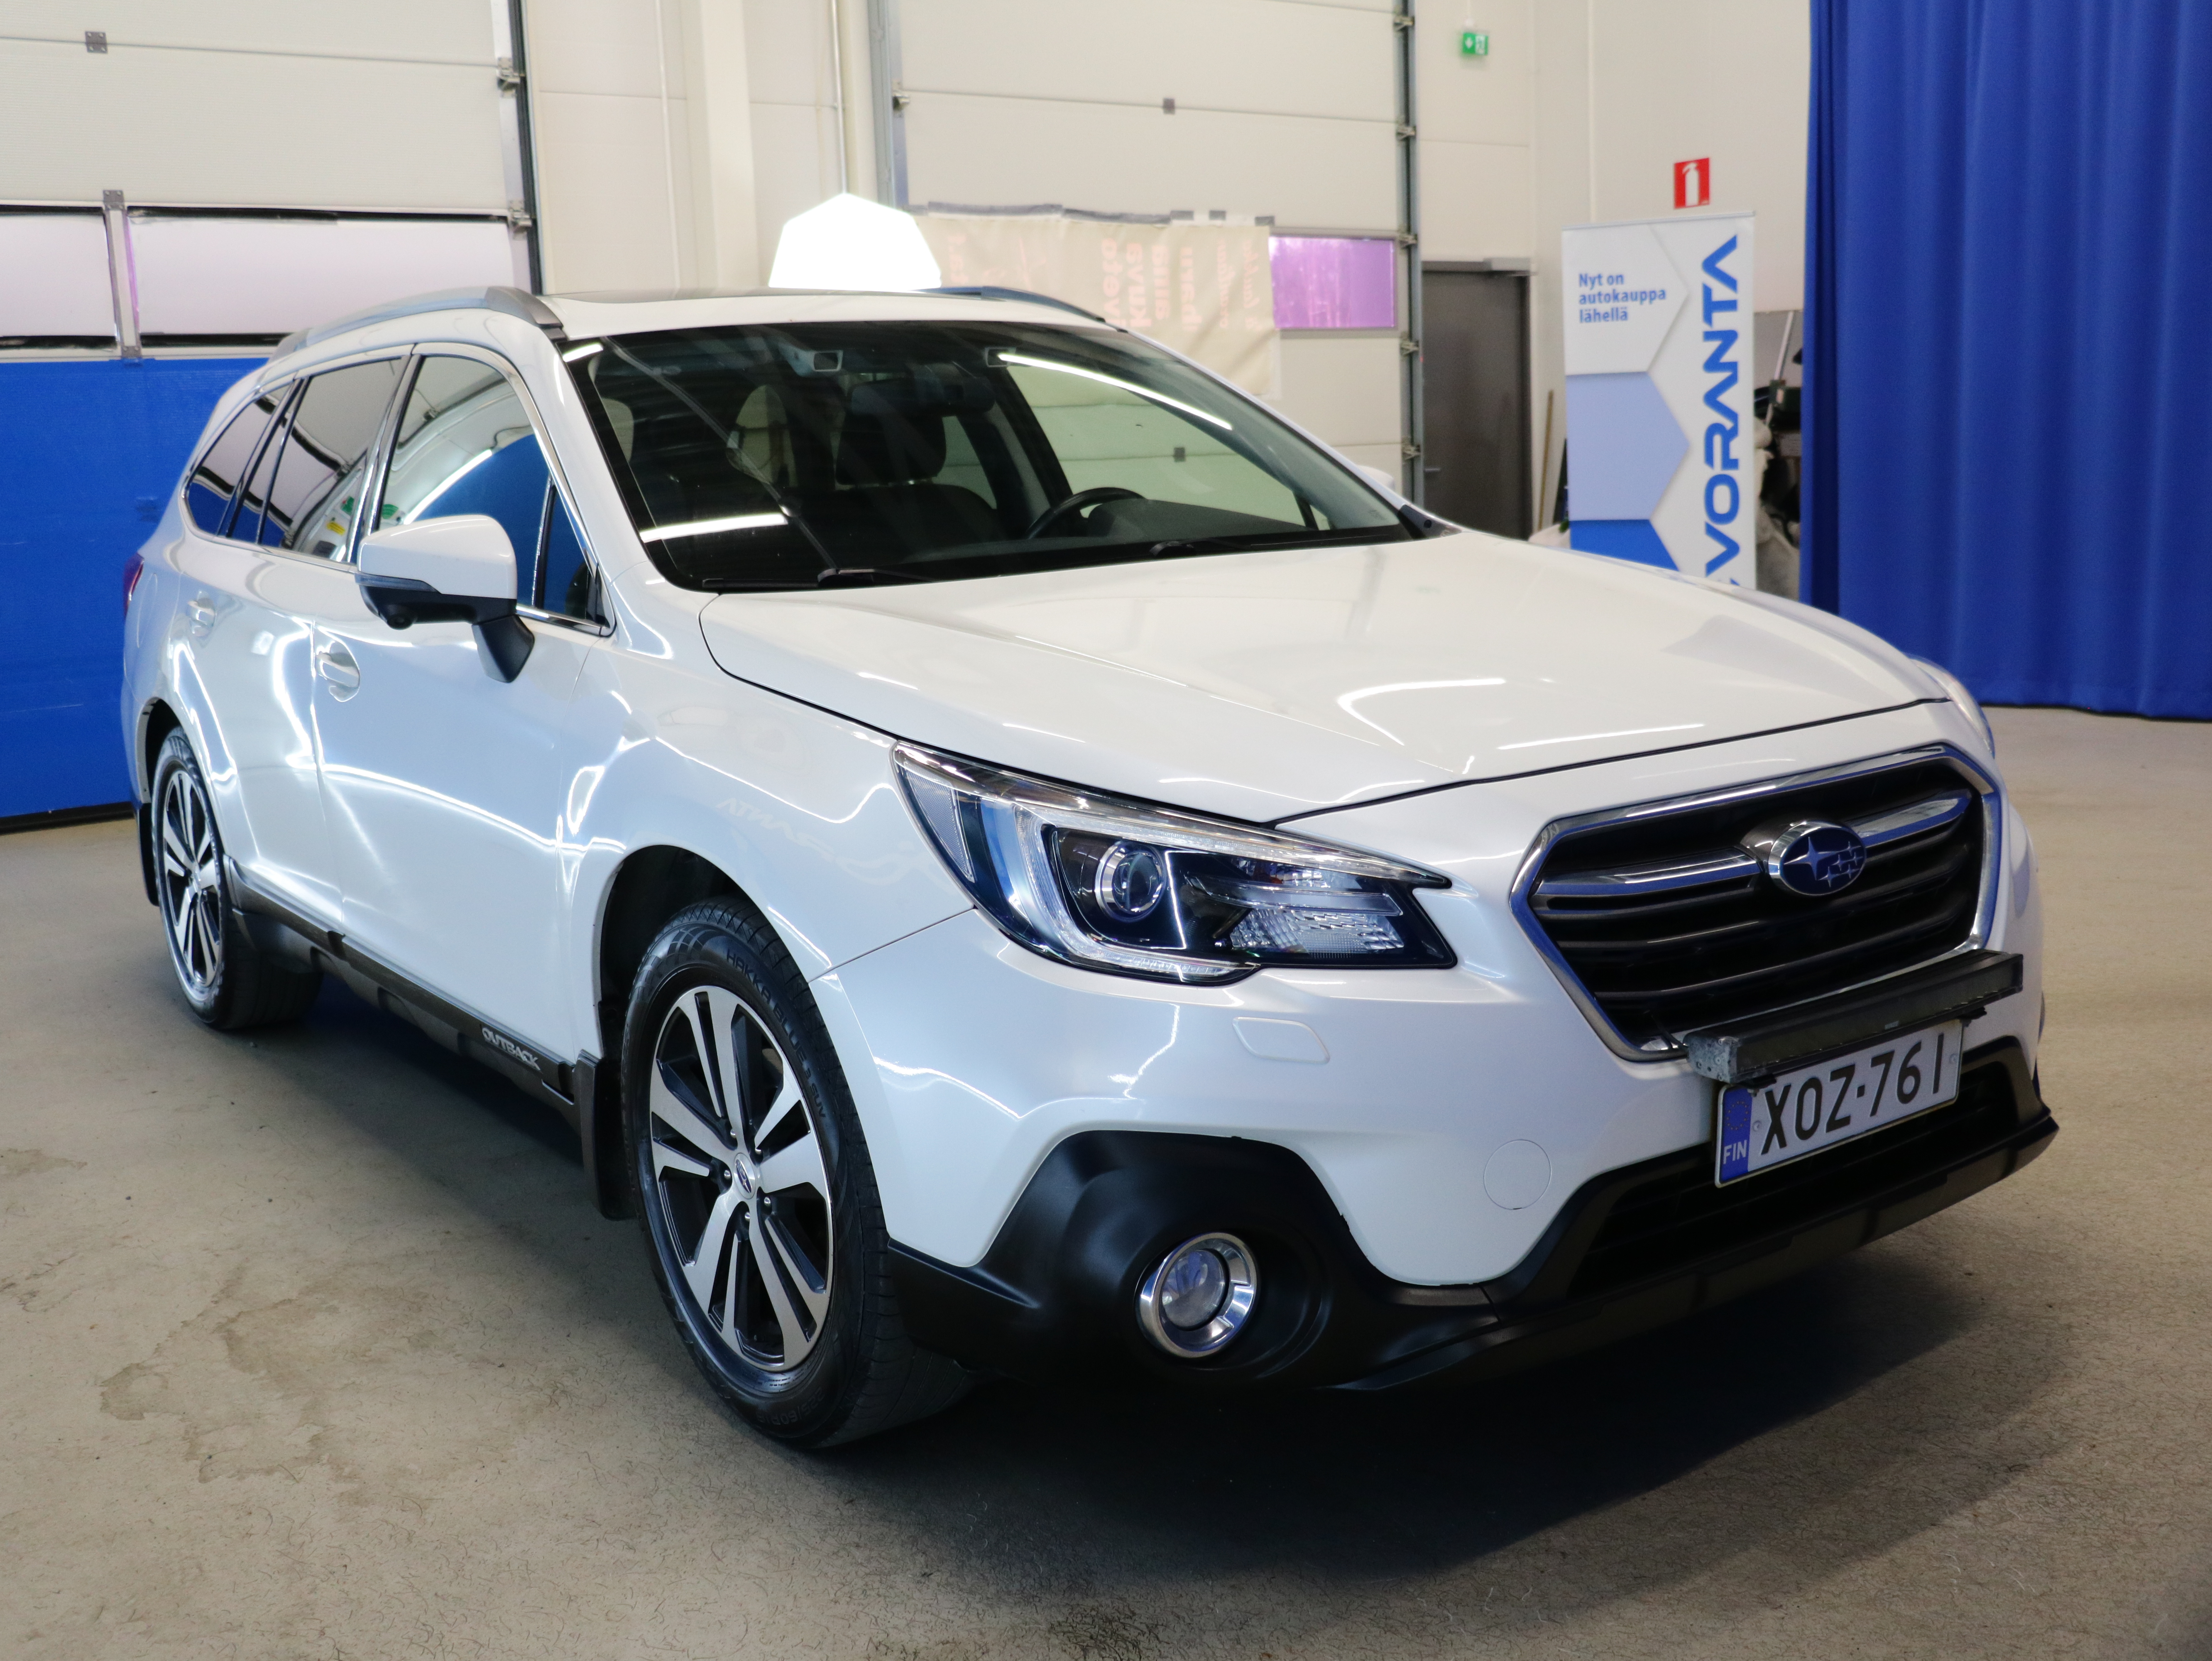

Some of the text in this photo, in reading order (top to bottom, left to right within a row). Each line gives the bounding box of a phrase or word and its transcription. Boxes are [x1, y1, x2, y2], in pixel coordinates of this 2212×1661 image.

[1579, 273, 1625, 290] Nyt on
[1579, 289, 1666, 305] autokauppa
[1580, 307, 1628, 323] lähellä
[1702, 233, 1741, 586] VORANTA
[482, 1027, 541, 1071] OUTBACK
[726, 949, 771, 1004] HAKKA
[773, 1002, 807, 1067] BLUE
[810, 1083, 826, 1118] SUV
[1761, 1033, 1944, 1155] XOZ-761
[1723, 1139, 1747, 1164] FIN
